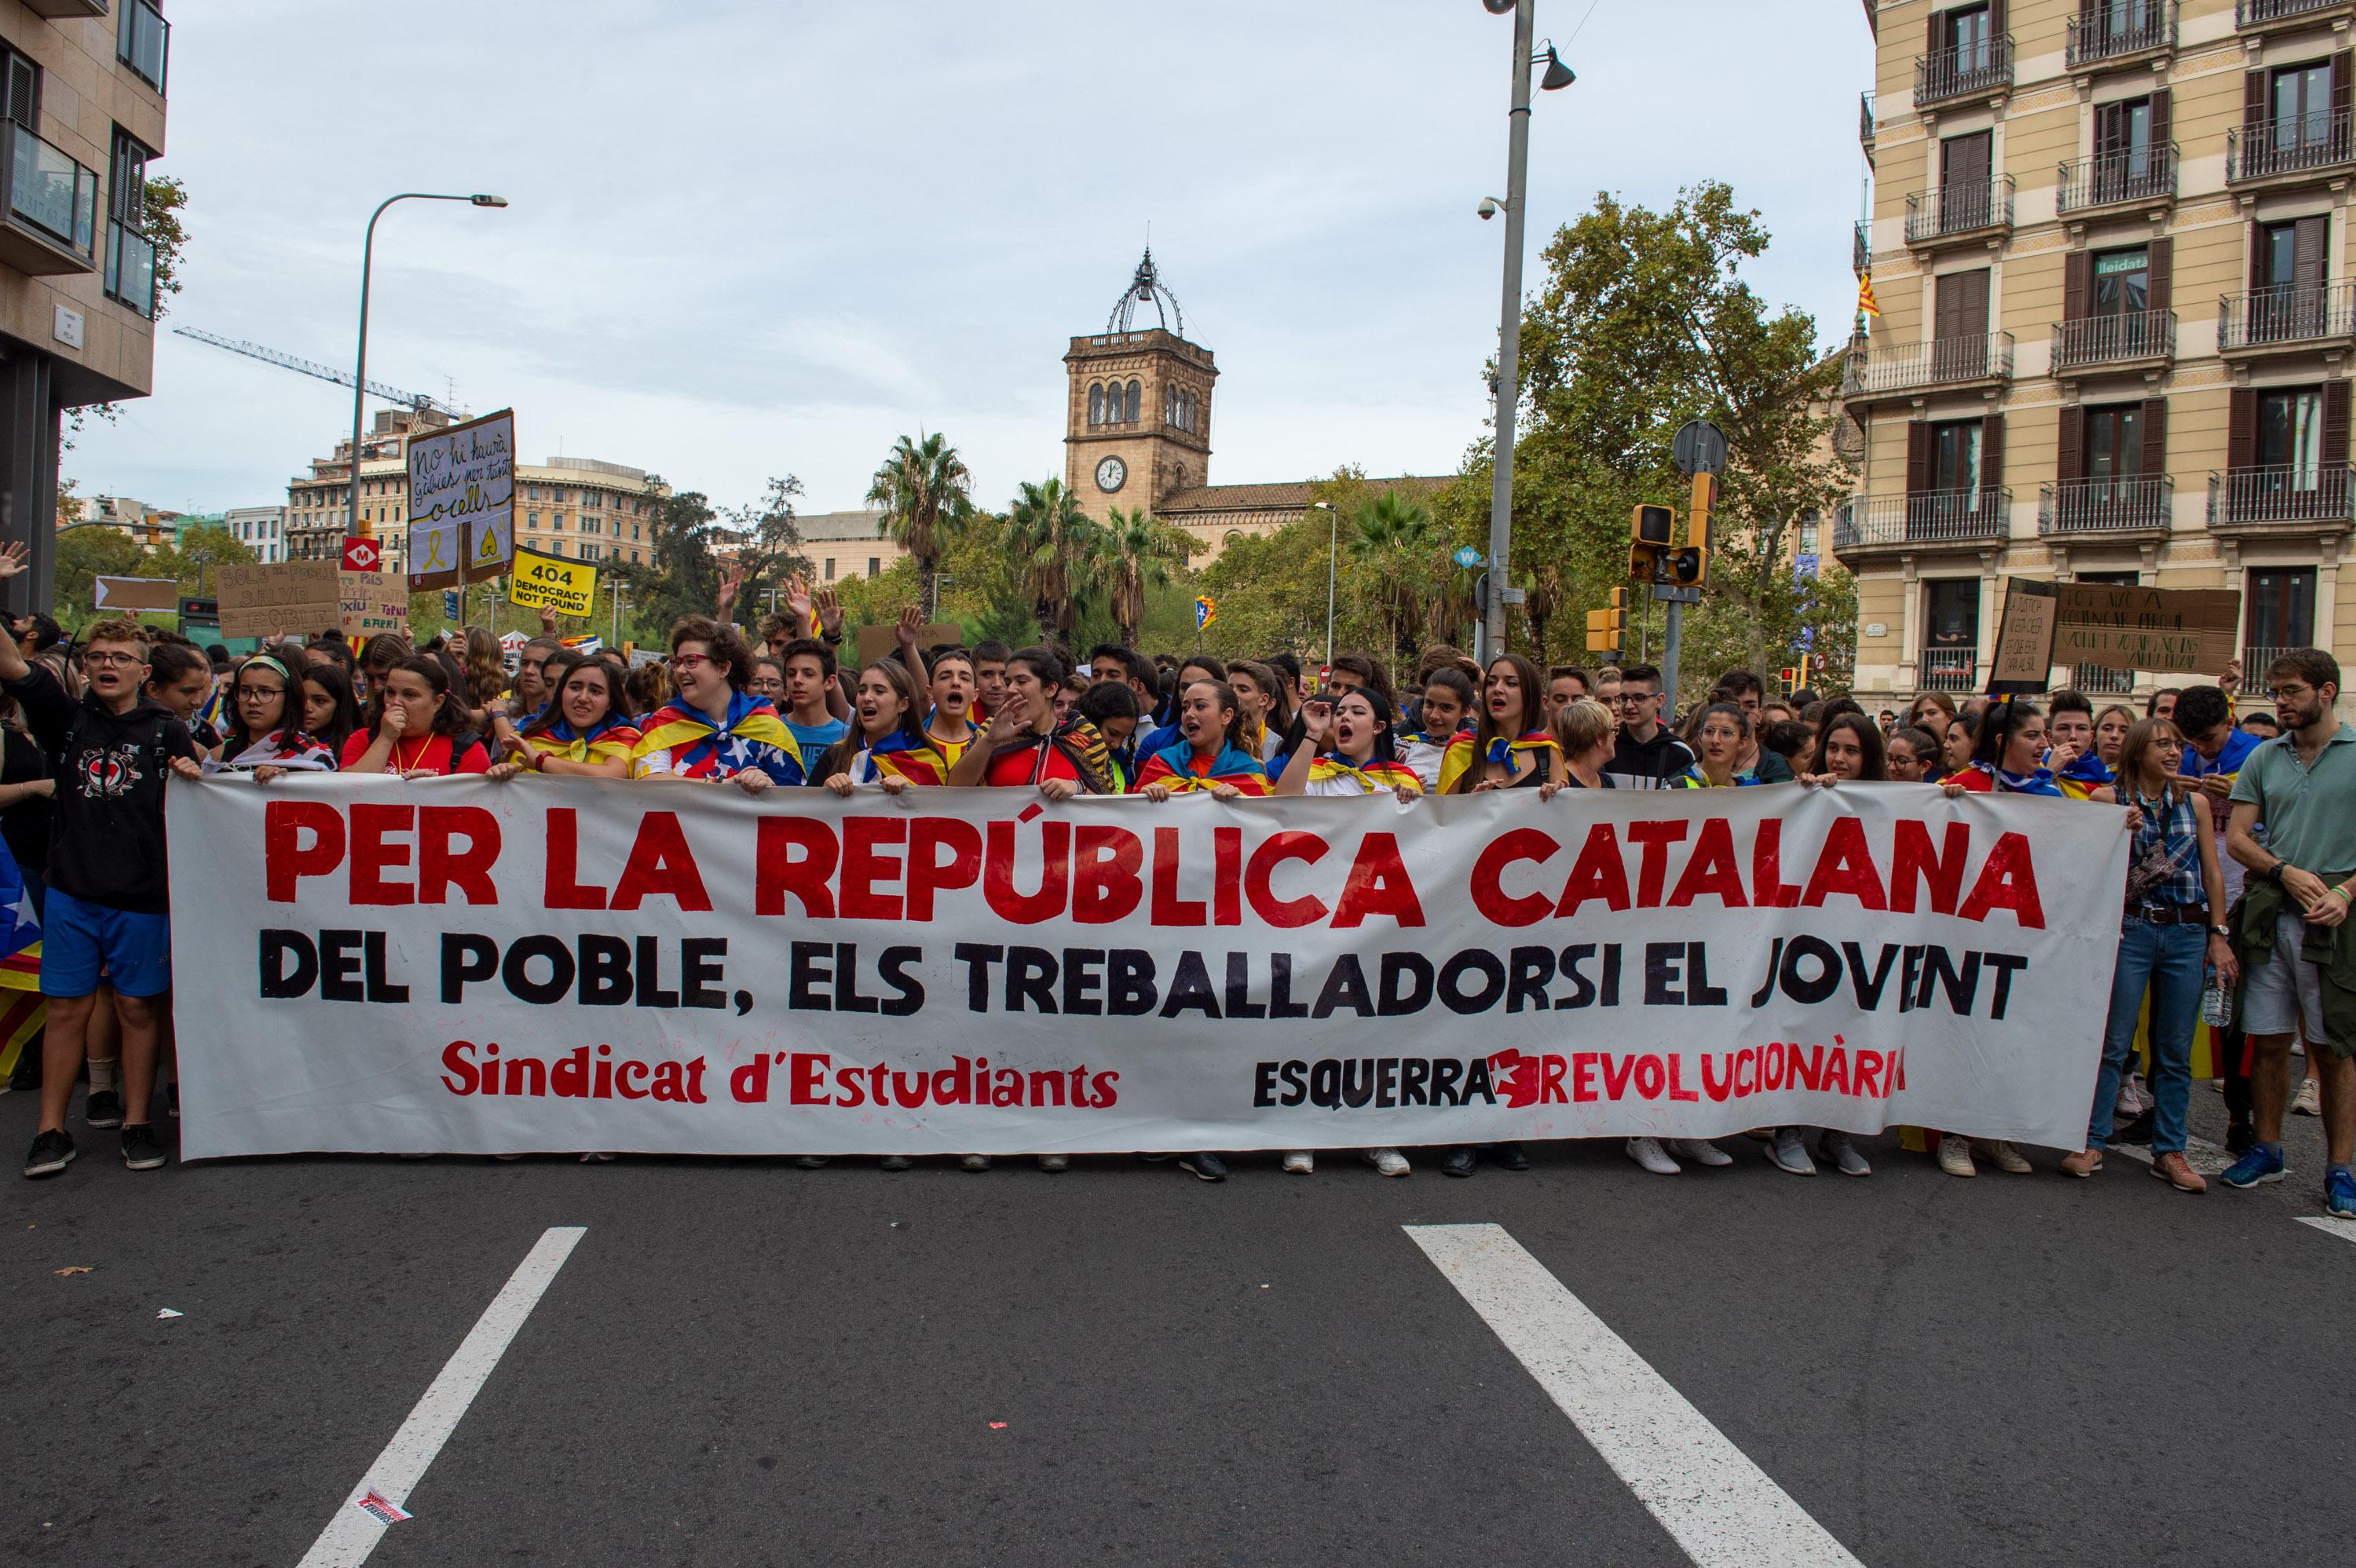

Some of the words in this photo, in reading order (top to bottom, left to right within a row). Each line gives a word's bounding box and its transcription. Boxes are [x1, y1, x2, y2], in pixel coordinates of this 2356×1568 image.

[356, 550, 368, 561] M
[1460, 552, 1476, 563] W
[289, 565, 337, 582] POBLE
[531, 565, 573, 586] 404
[515, 579, 590, 602] DEMOCRACY
[516, 590, 540, 604] NOT
[542, 595, 585, 612] FOUND
[265, 801, 502, 906] PER
[544, 807, 713, 912] LA
[755, 804, 1426, 929] REPÚBLICA
[1470, 817, 2046, 930] CATALANA
[259, 929, 410, 1003] DEL
[441, 933, 753, 1016] POBLE,
[789, 941, 925, 1016] ELS
[1644, 941, 1728, 1006] EL
[1751, 934, 2028, 1020] JOVENT
[441, 1040, 708, 1104] Sindicat
[730, 1051, 1120, 1109] d'Estudiants
[1253, 1058, 1497, 1112] ESQUERRA
